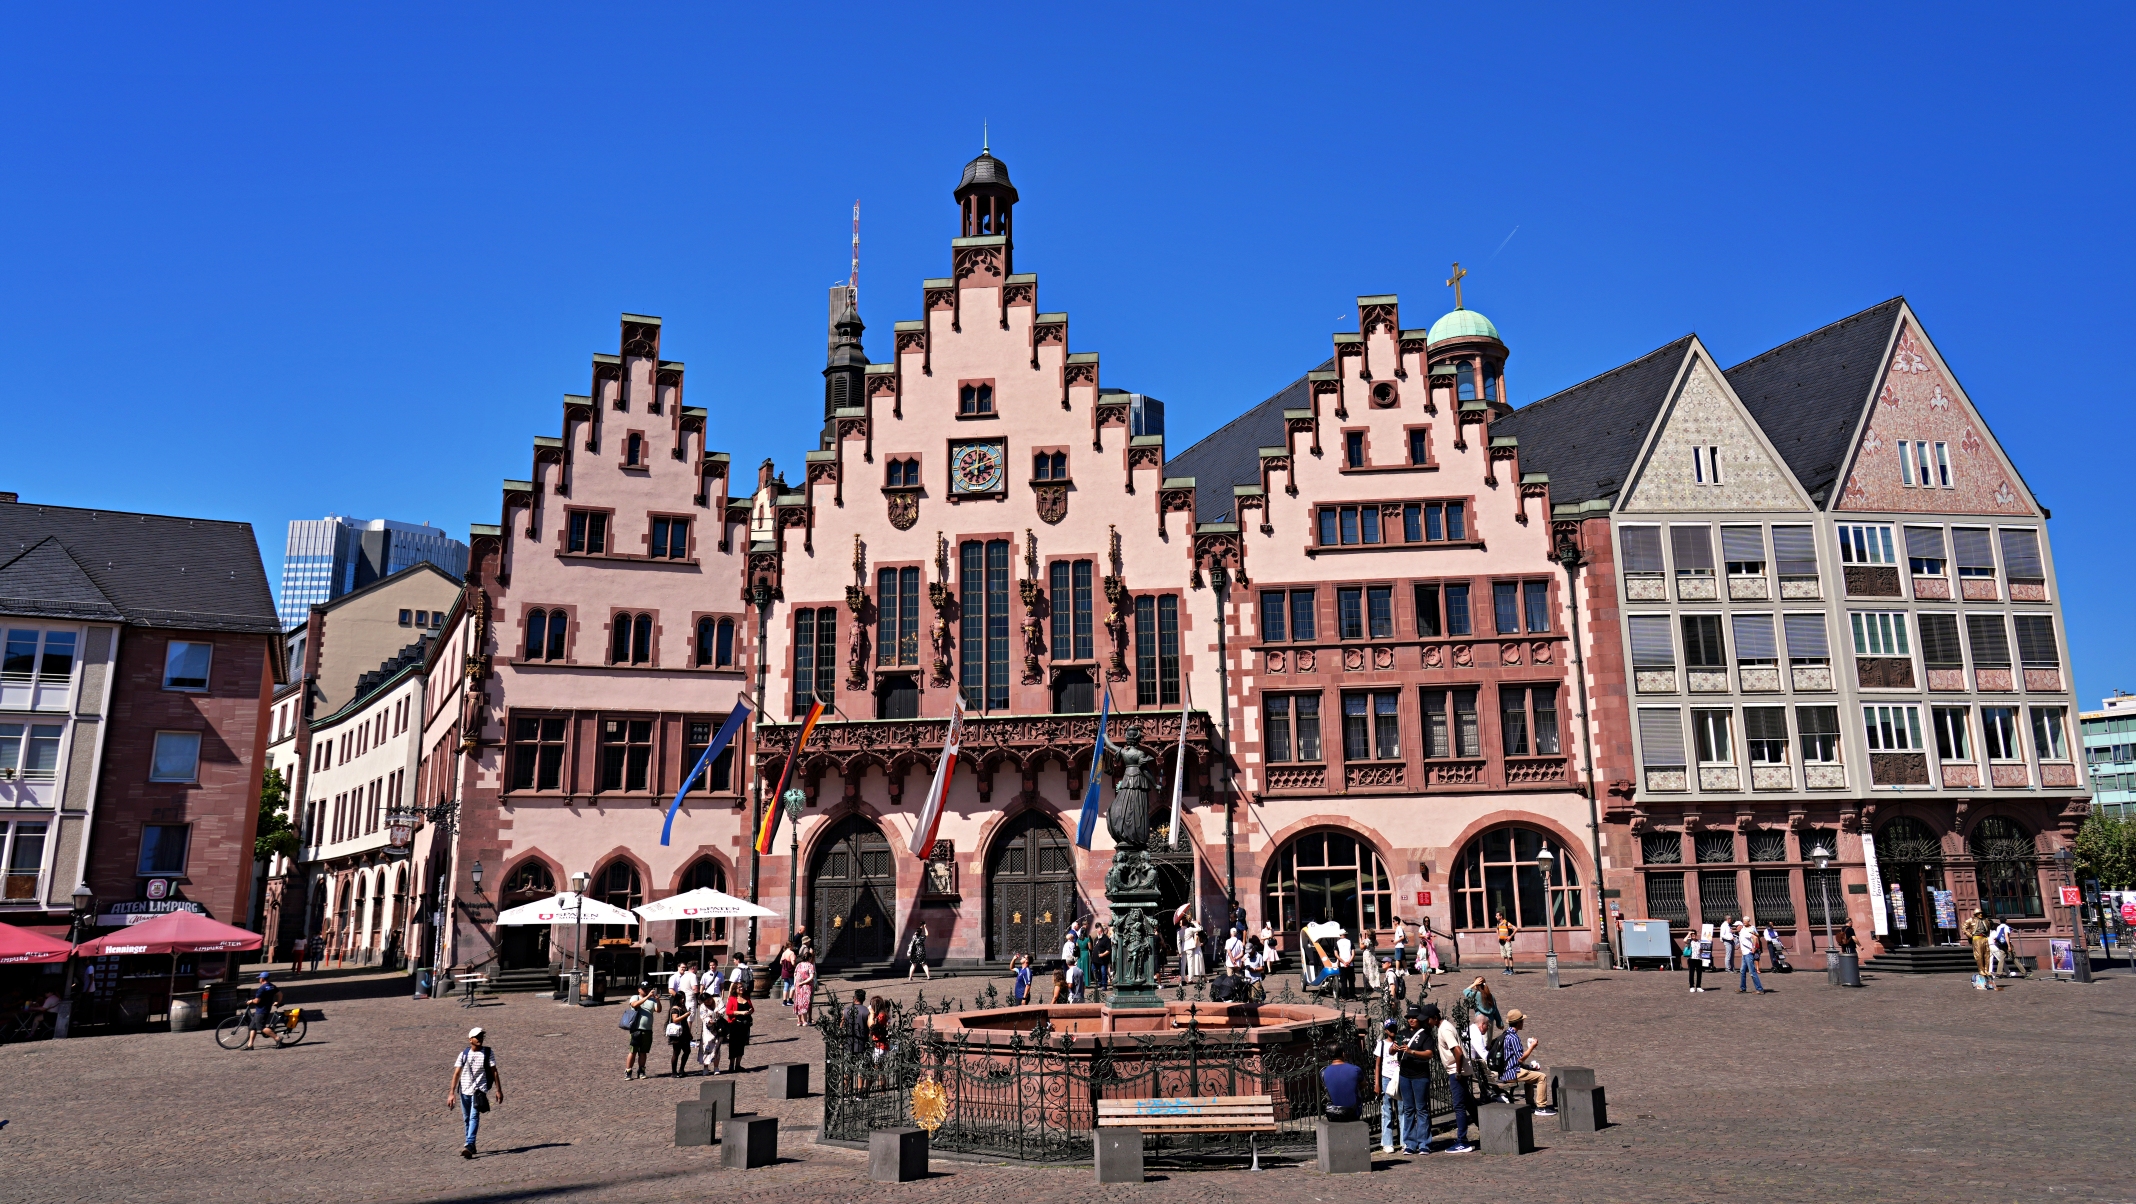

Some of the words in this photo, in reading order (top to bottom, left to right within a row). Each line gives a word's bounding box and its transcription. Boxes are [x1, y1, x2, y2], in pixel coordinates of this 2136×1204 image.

[111, 901, 148, 914] ALTEN
[149, 901, 198, 913] LIMPURG
[105, 945, 148, 954] Henninger
